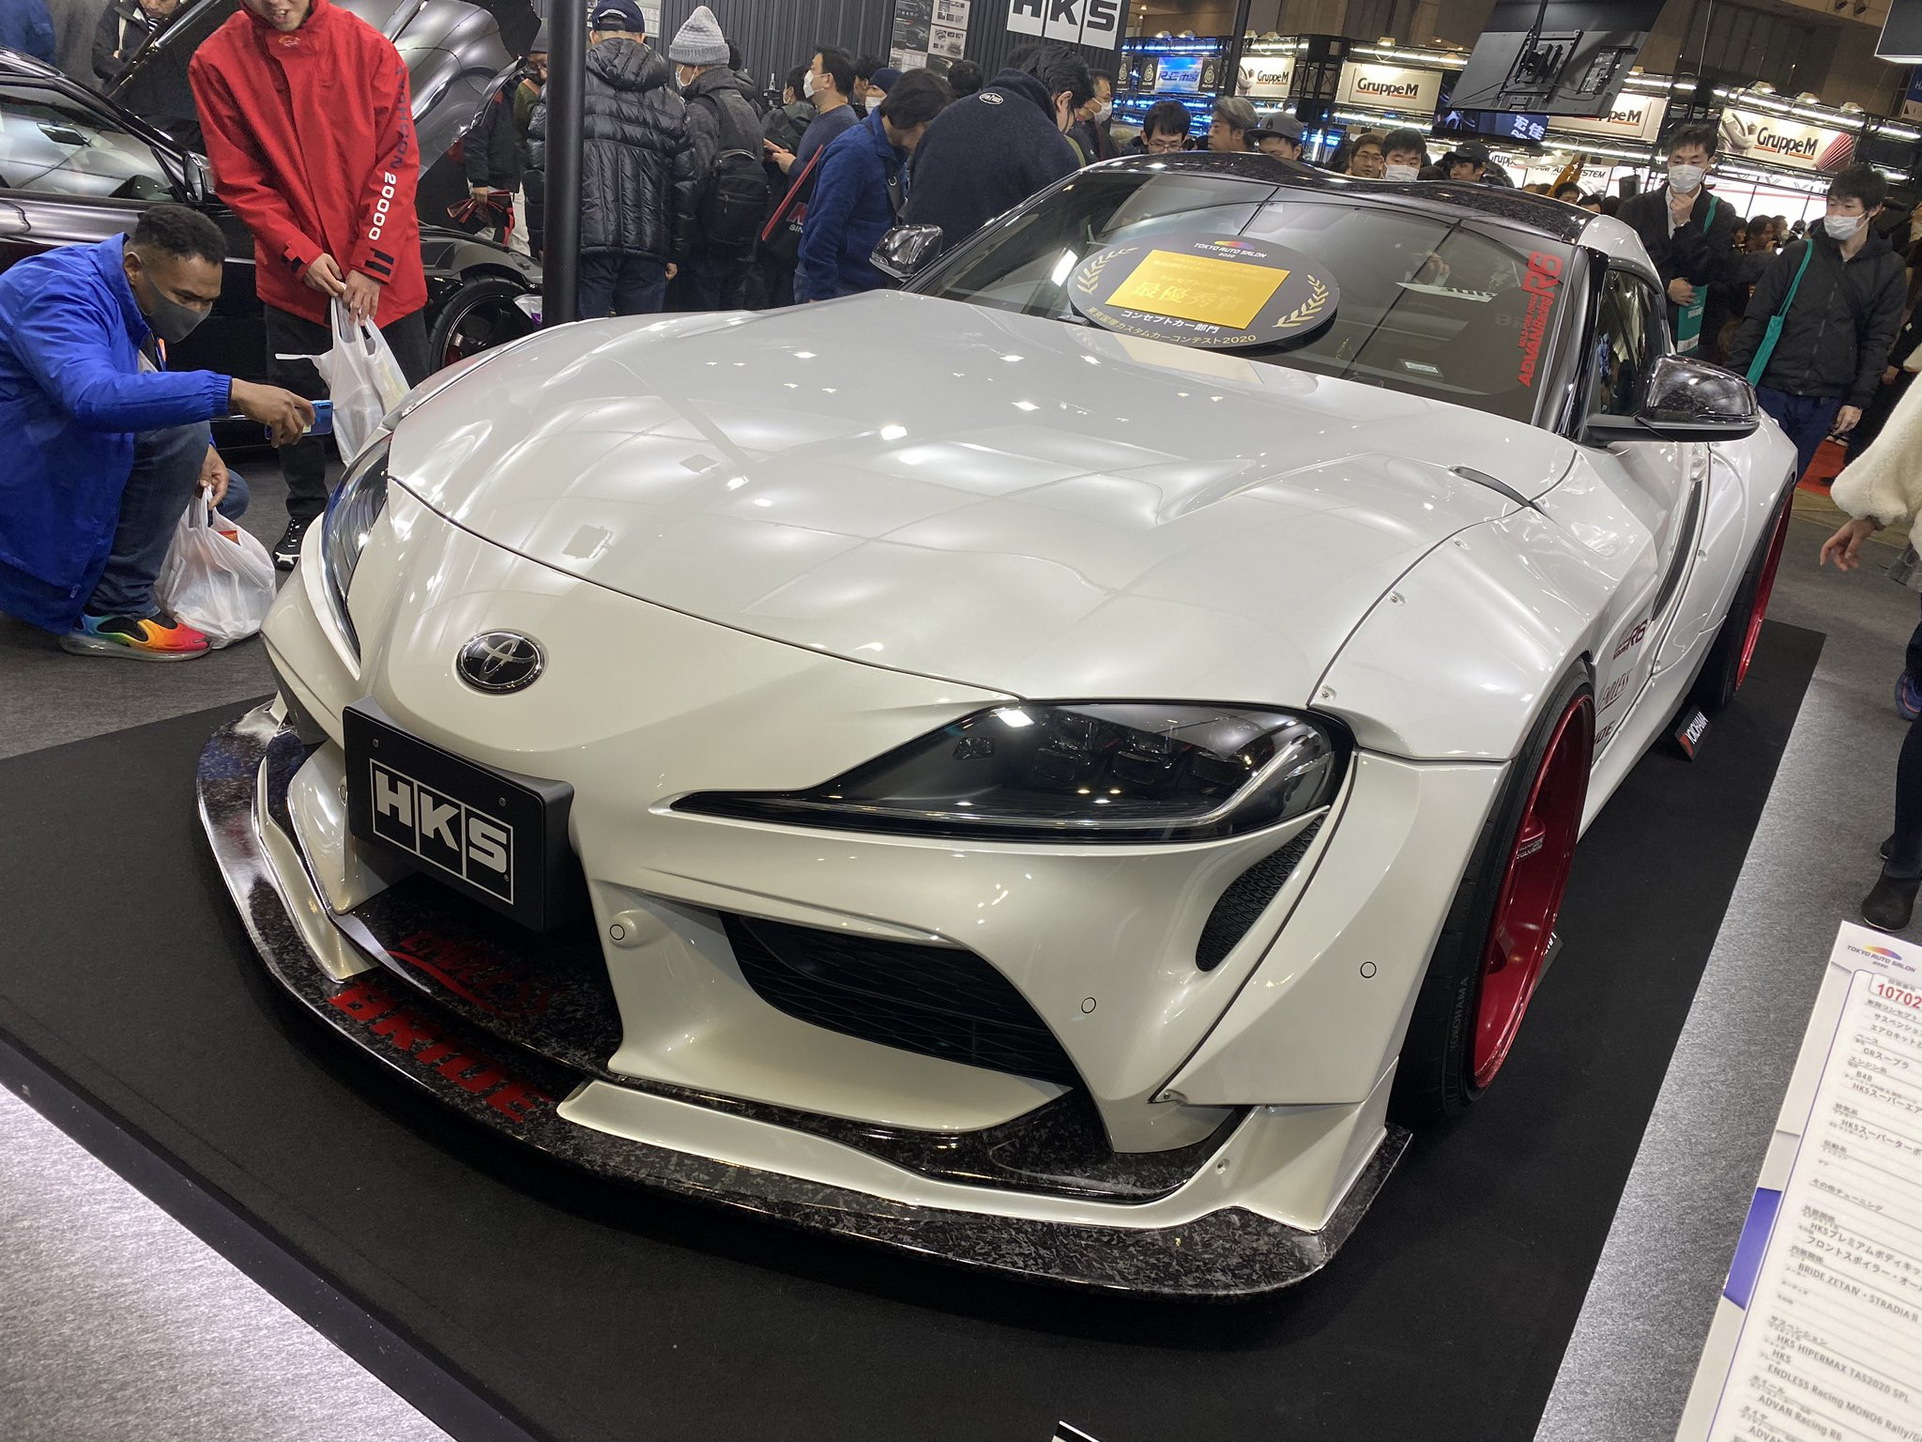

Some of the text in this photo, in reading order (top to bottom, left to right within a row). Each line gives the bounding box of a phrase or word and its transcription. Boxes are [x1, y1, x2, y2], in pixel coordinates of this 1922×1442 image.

[1011, 0, 1118, 32] HKS
[1257, 70, 1289, 84] GruppeM
[1357, 77, 1419, 97] GruppeM
[1757, 127, 1819, 156] GruppeM
[368, 171, 397, 241] 20000
[1193, 242, 1268, 259] TOKYO AUTO SALON
[1521, 251, 1563, 299] R6
[1121, 310, 1220, 334] コンセプトカー部門
[1517, 328, 1543, 388] ADVAN
[375, 769, 508, 874] HKS
[1847, 945, 1916, 973] TOKYO AUTO SALON
[1875, 1013, 1922, 1035] サスペンショ
[326, 981, 554, 1122] BRIDE
[1798, 1262, 1825, 1281] BRIDE
[1807, 1235, 1922, 1292] フロントスポイラー・オー
[1772, 1349, 1792, 1364] HKS
[1777, 1334, 1796, 1350] HKS
[1798, 1343, 1848, 1374] HIPERMAX
[1768, 1363, 1809, 1391] ENDLESS
[1812, 1384, 1844, 1410] Racing
[1759, 1394, 1793, 1417] ADVAN
[1795, 1412, 1828, 1436] Racing
